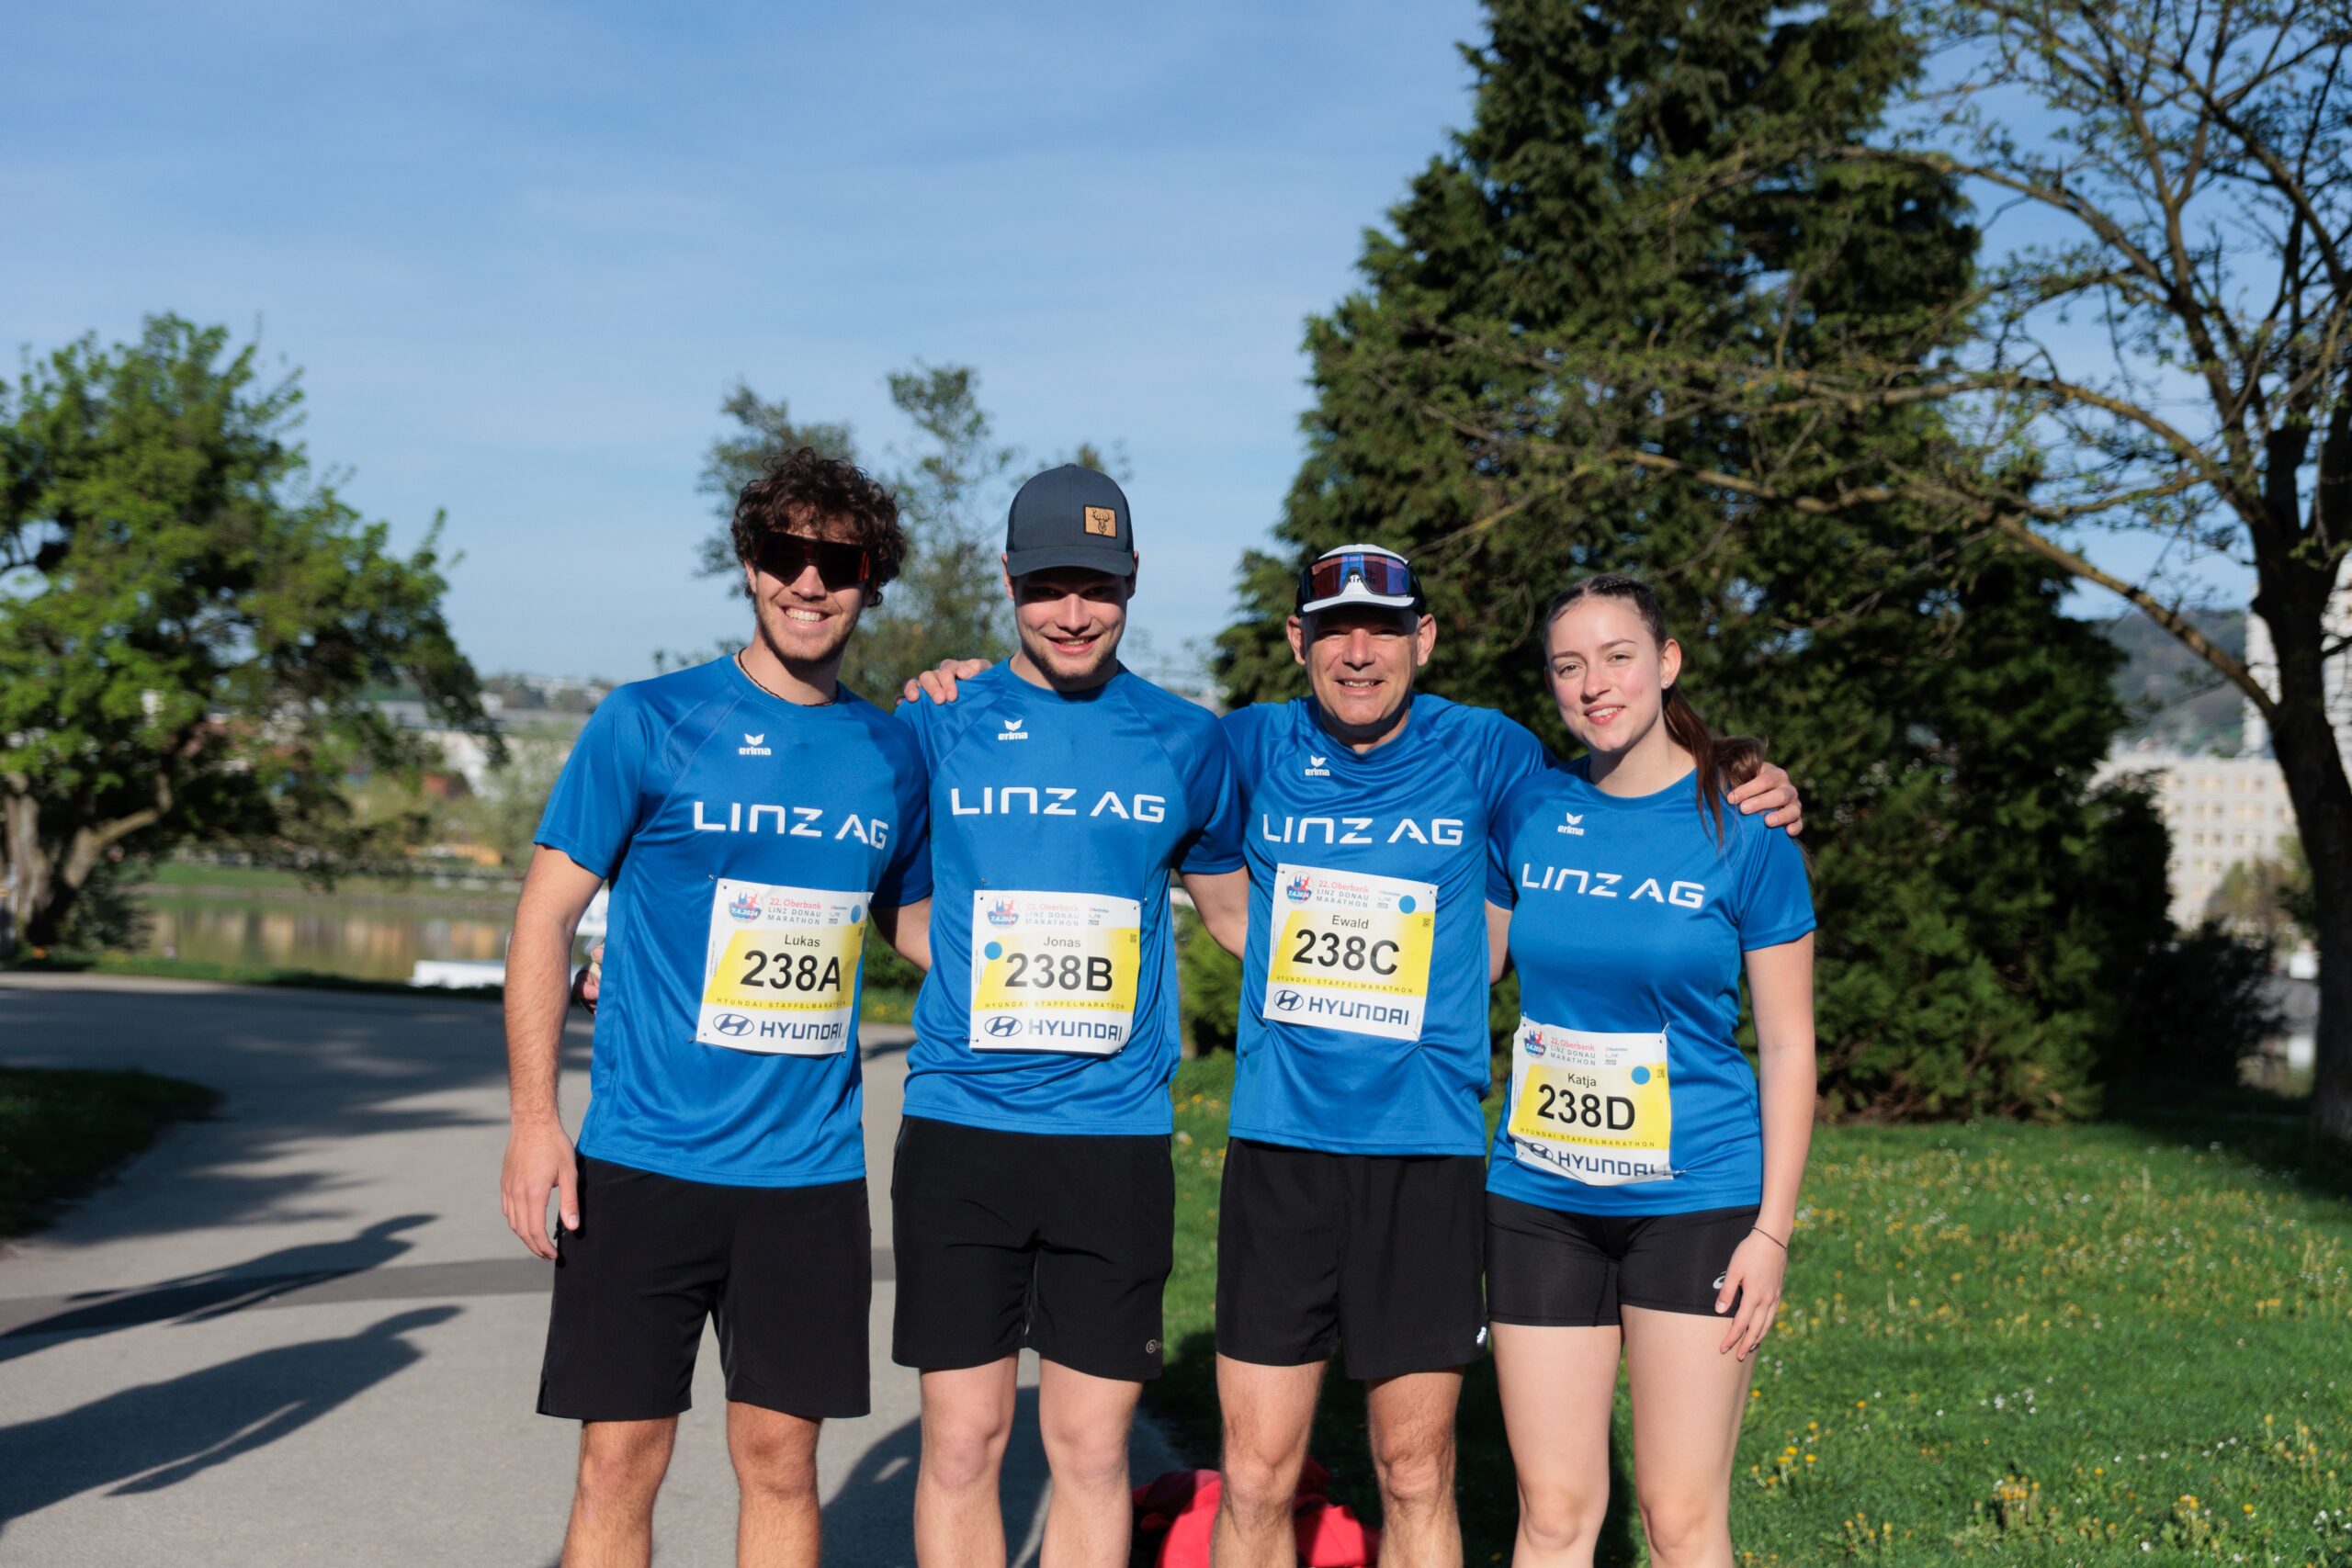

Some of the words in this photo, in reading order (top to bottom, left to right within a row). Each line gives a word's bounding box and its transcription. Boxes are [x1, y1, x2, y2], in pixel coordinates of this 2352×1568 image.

[998, 731, 1028, 740] erima
[739, 747, 772, 756] erima
[1305, 768, 1330, 776] erima
[951, 786, 1077, 816] LINZ
[1090, 791, 1166, 823] AG
[694, 801, 823, 838] LINZ
[835, 814, 888, 850] AG
[1263, 814, 1374, 844] LINZ
[1386, 818, 1464, 846] AG
[1557, 825, 1584, 836] erima
[1318, 880, 1329, 888] 22.
[1331, 882, 1369, 894] Oberbank
[1521, 863, 1623, 897] LINZ
[1628, 878, 1705, 909] AG
[1317, 888, 1335, 897] LINZ
[1339, 890, 1369, 901] DONAU
[770, 897, 782, 907] 22.
[784, 899, 822, 910] Oberbank
[1316, 896, 1368, 908] MARATHON
[768, 907, 787, 915] LINZ
[791, 909, 821, 918] DONAU
[766, 915, 820, 925] MARATHON
[1025, 919, 1079, 927] MARATHON
[1331, 915, 1369, 930] Ewald
[785, 934, 820, 947] Lukas
[1044, 936, 1081, 948] Jonas
[1292, 929, 1399, 976] 238C
[741, 950, 841, 991] 238A
[1004, 953, 1113, 992] 238B
[717, 997, 763, 1007] HYUNDAI
[1308, 996, 1409, 1026] HYUNDAI
[760, 1021, 842, 1041] HYUNDAI
[1029, 1019, 1123, 1042] HYUNDAI
[1550, 1036, 1560, 1045] 22.
[1561, 1039, 1595, 1052] Oberbank
[1550, 1044, 1564, 1054] LINZ
[1567, 1049, 1596, 1059] DONAU
[1550, 1052, 1596, 1066] MARATHON
[1567, 1073, 1597, 1089] Katja
[1537, 1084, 1635, 1131] 238D
